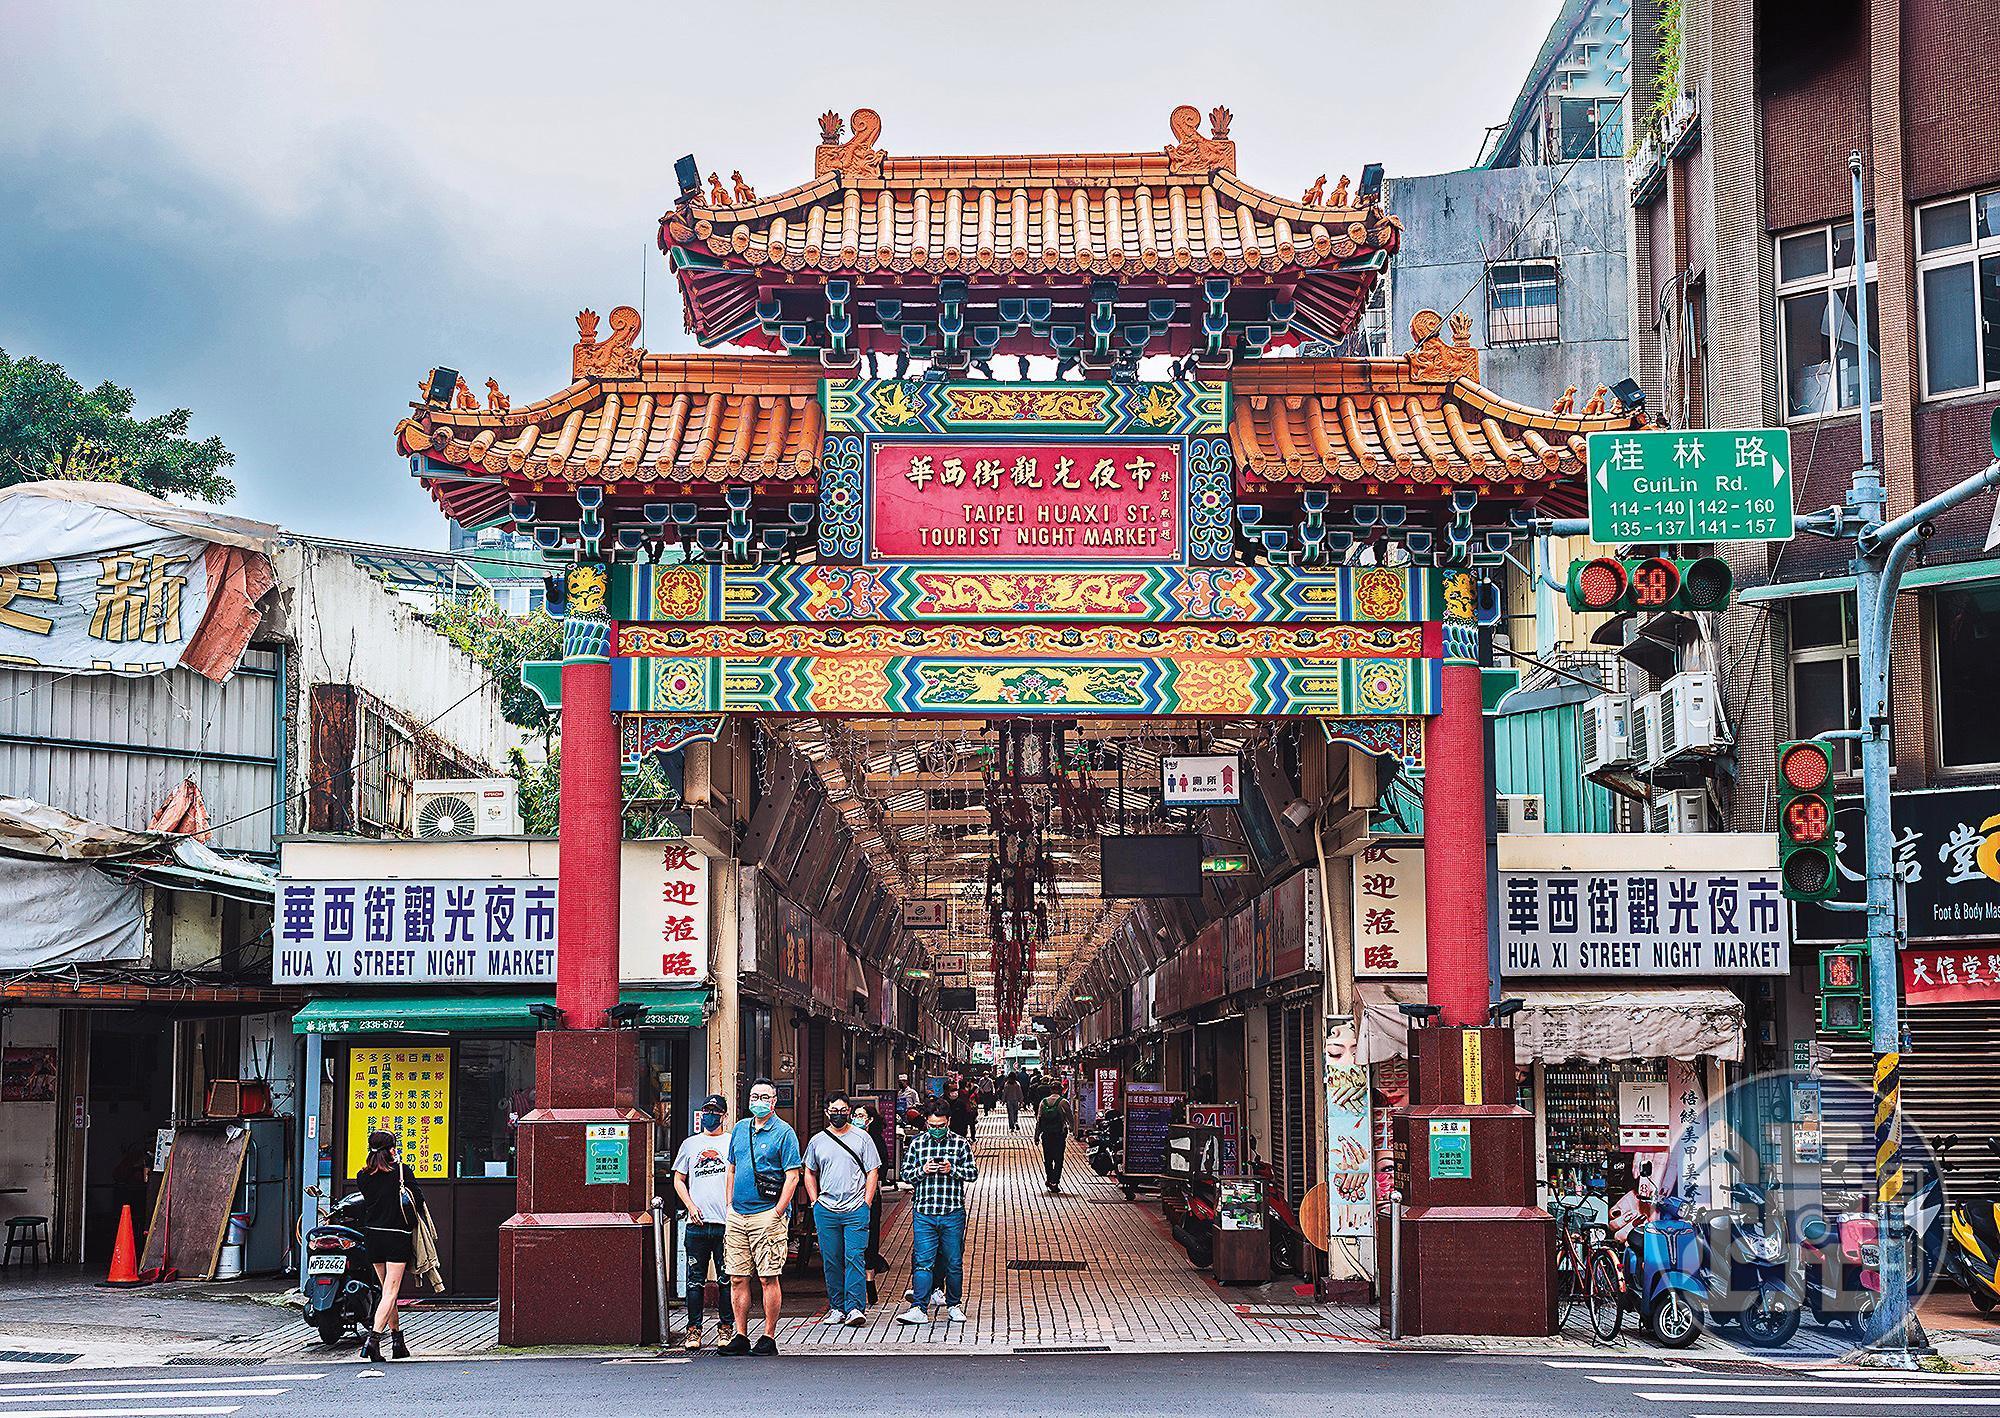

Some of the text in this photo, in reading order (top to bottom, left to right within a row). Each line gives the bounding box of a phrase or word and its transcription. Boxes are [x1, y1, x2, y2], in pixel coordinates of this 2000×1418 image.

[1609, 436, 1769, 471] 桂林路
[904, 455, 1157, 491] 華西街觀光夜市
[1633, 475, 1748, 494] GuiLin Rd.
[963, 503, 1156, 523] TAIPEI HUAXI ST.
[919, 527, 1158, 547] TOURIST NIGHT MARKET
[1633, 568, 1666, 605] 58
[1789, 803, 1826, 841] 58
[282, 885, 556, 943] 華西街觀光夜市
[661, 845, 701, 976] 歡迎蒞臨
[1507, 876, 1780, 935] 華西街觀光夜市
[1933, 903, 1952, 920] Foot
[1954, 902, 1961, 919] &
[1963, 902, 1983, 921] Body
[281, 949, 555, 977] HUA XI STREET NIGHT MARKET
[1508, 942, 1780, 969] HUA XI STREET NIGHT MARKET
[360, 1019, 405, 1030] 2336-6792
[645, 1014, 690, 1025] 2336-6792
[354, 1101, 364, 1110] 30
[367, 1101, 378, 1110] 40
[380, 1101, 391, 1110] 40
[394, 1101, 404, 1110] 30
[407, 1101, 417, 1110] 30
[420, 1101, 430, 1110] 30
[433, 1101, 443, 1110] 30
[598, 1126, 616, 1136] 注意
[1441, 1122, 1459, 1131] 注意
[433, 1163, 443, 1173] 50
